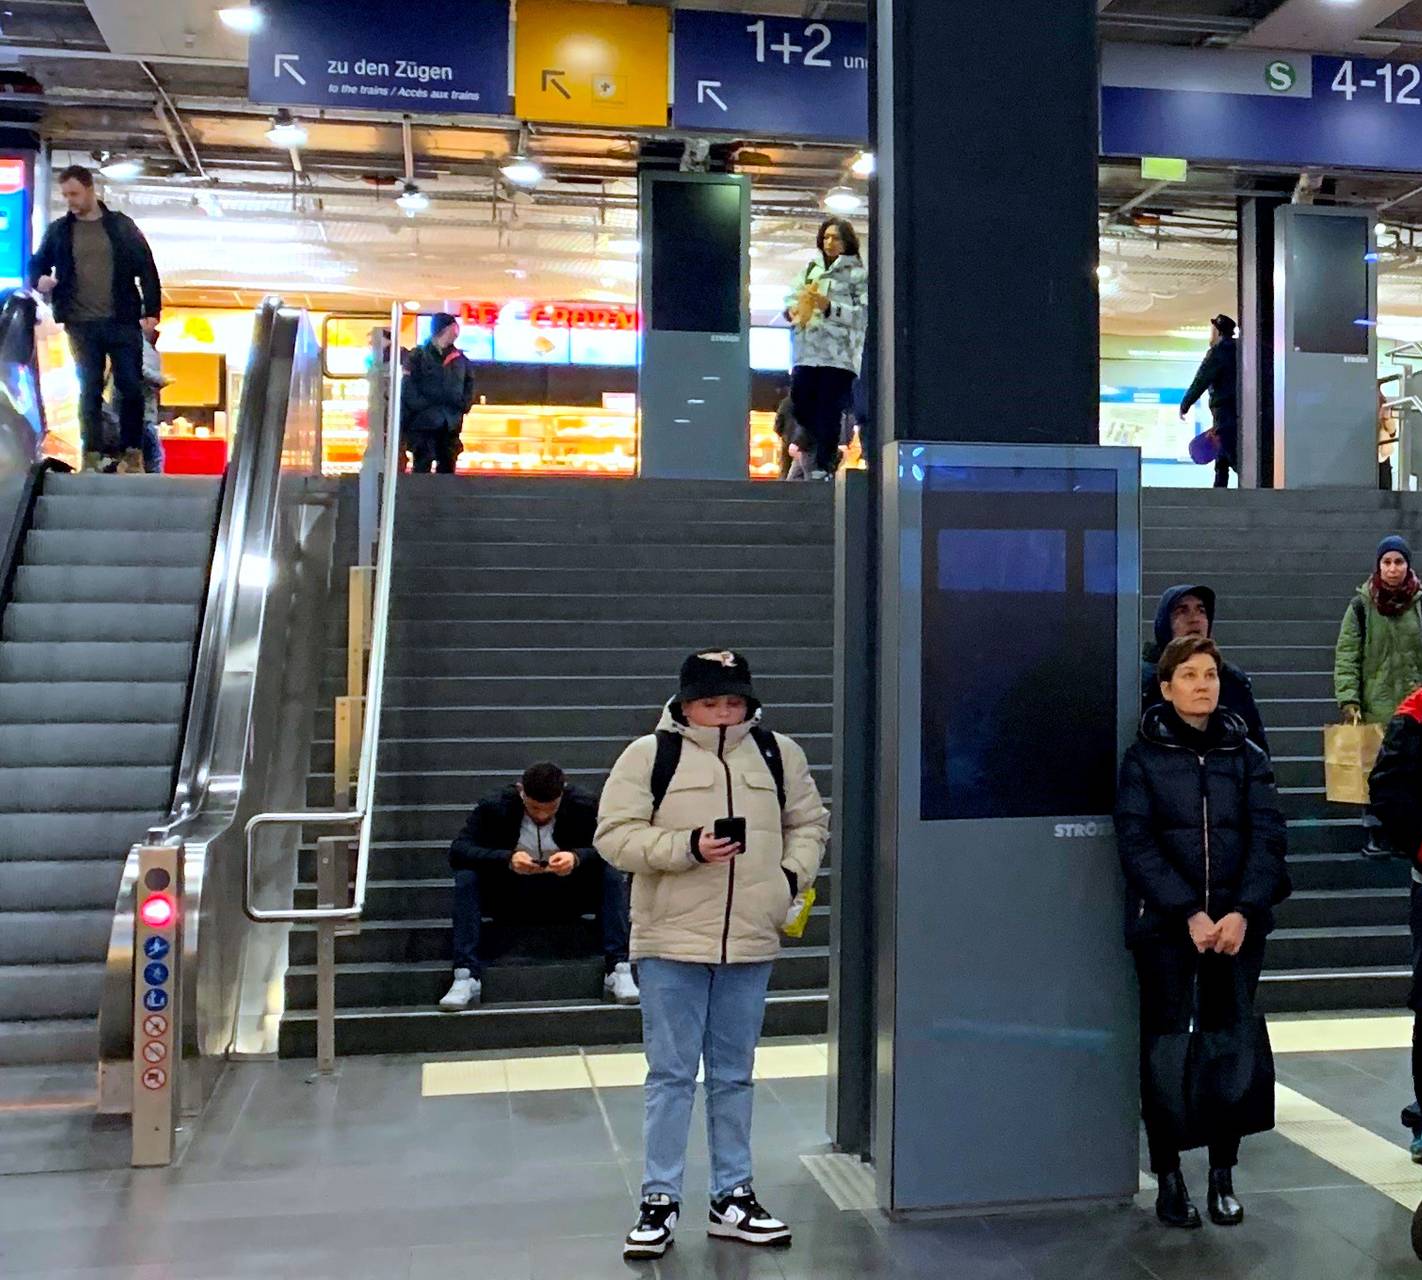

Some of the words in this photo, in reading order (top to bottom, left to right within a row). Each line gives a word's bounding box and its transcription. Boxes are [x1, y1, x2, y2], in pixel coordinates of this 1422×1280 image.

[746, 20, 832, 67] 1+2
[327, 60, 349, 74] zu
[354, 59, 389, 76] den
[394, 60, 453, 82] Zügen
[1269, 62, 1292, 91] S
[1331, 60, 1421, 105] 4-12
[328, 83, 338, 93] to
[341, 84, 357, 95] the
[360, 85, 389, 96] trains
[451, 90, 480, 100] trains
